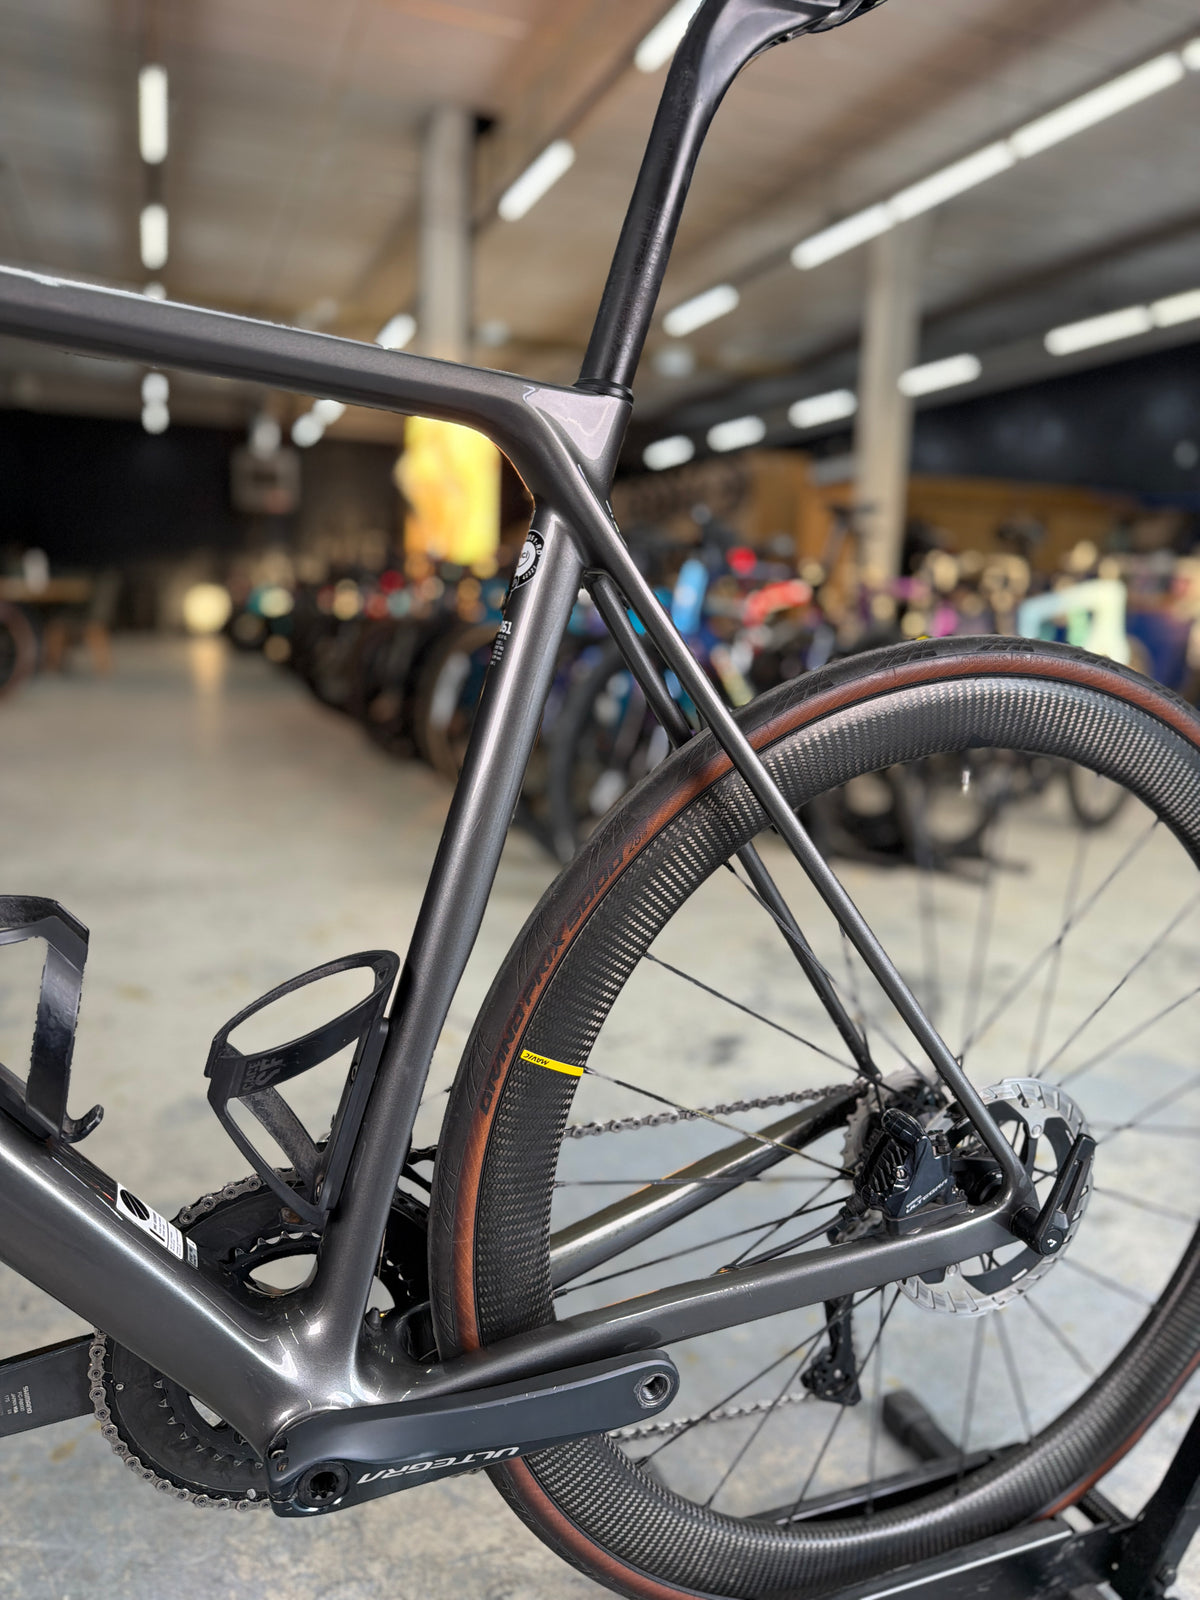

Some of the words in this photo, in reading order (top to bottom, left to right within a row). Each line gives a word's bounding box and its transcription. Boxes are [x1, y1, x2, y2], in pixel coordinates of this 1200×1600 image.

[521, 930, 565, 1006] PRIX
[523, 1052, 549, 1066] MAVIC
[356, 1446, 520, 1485] ULTEGRA
